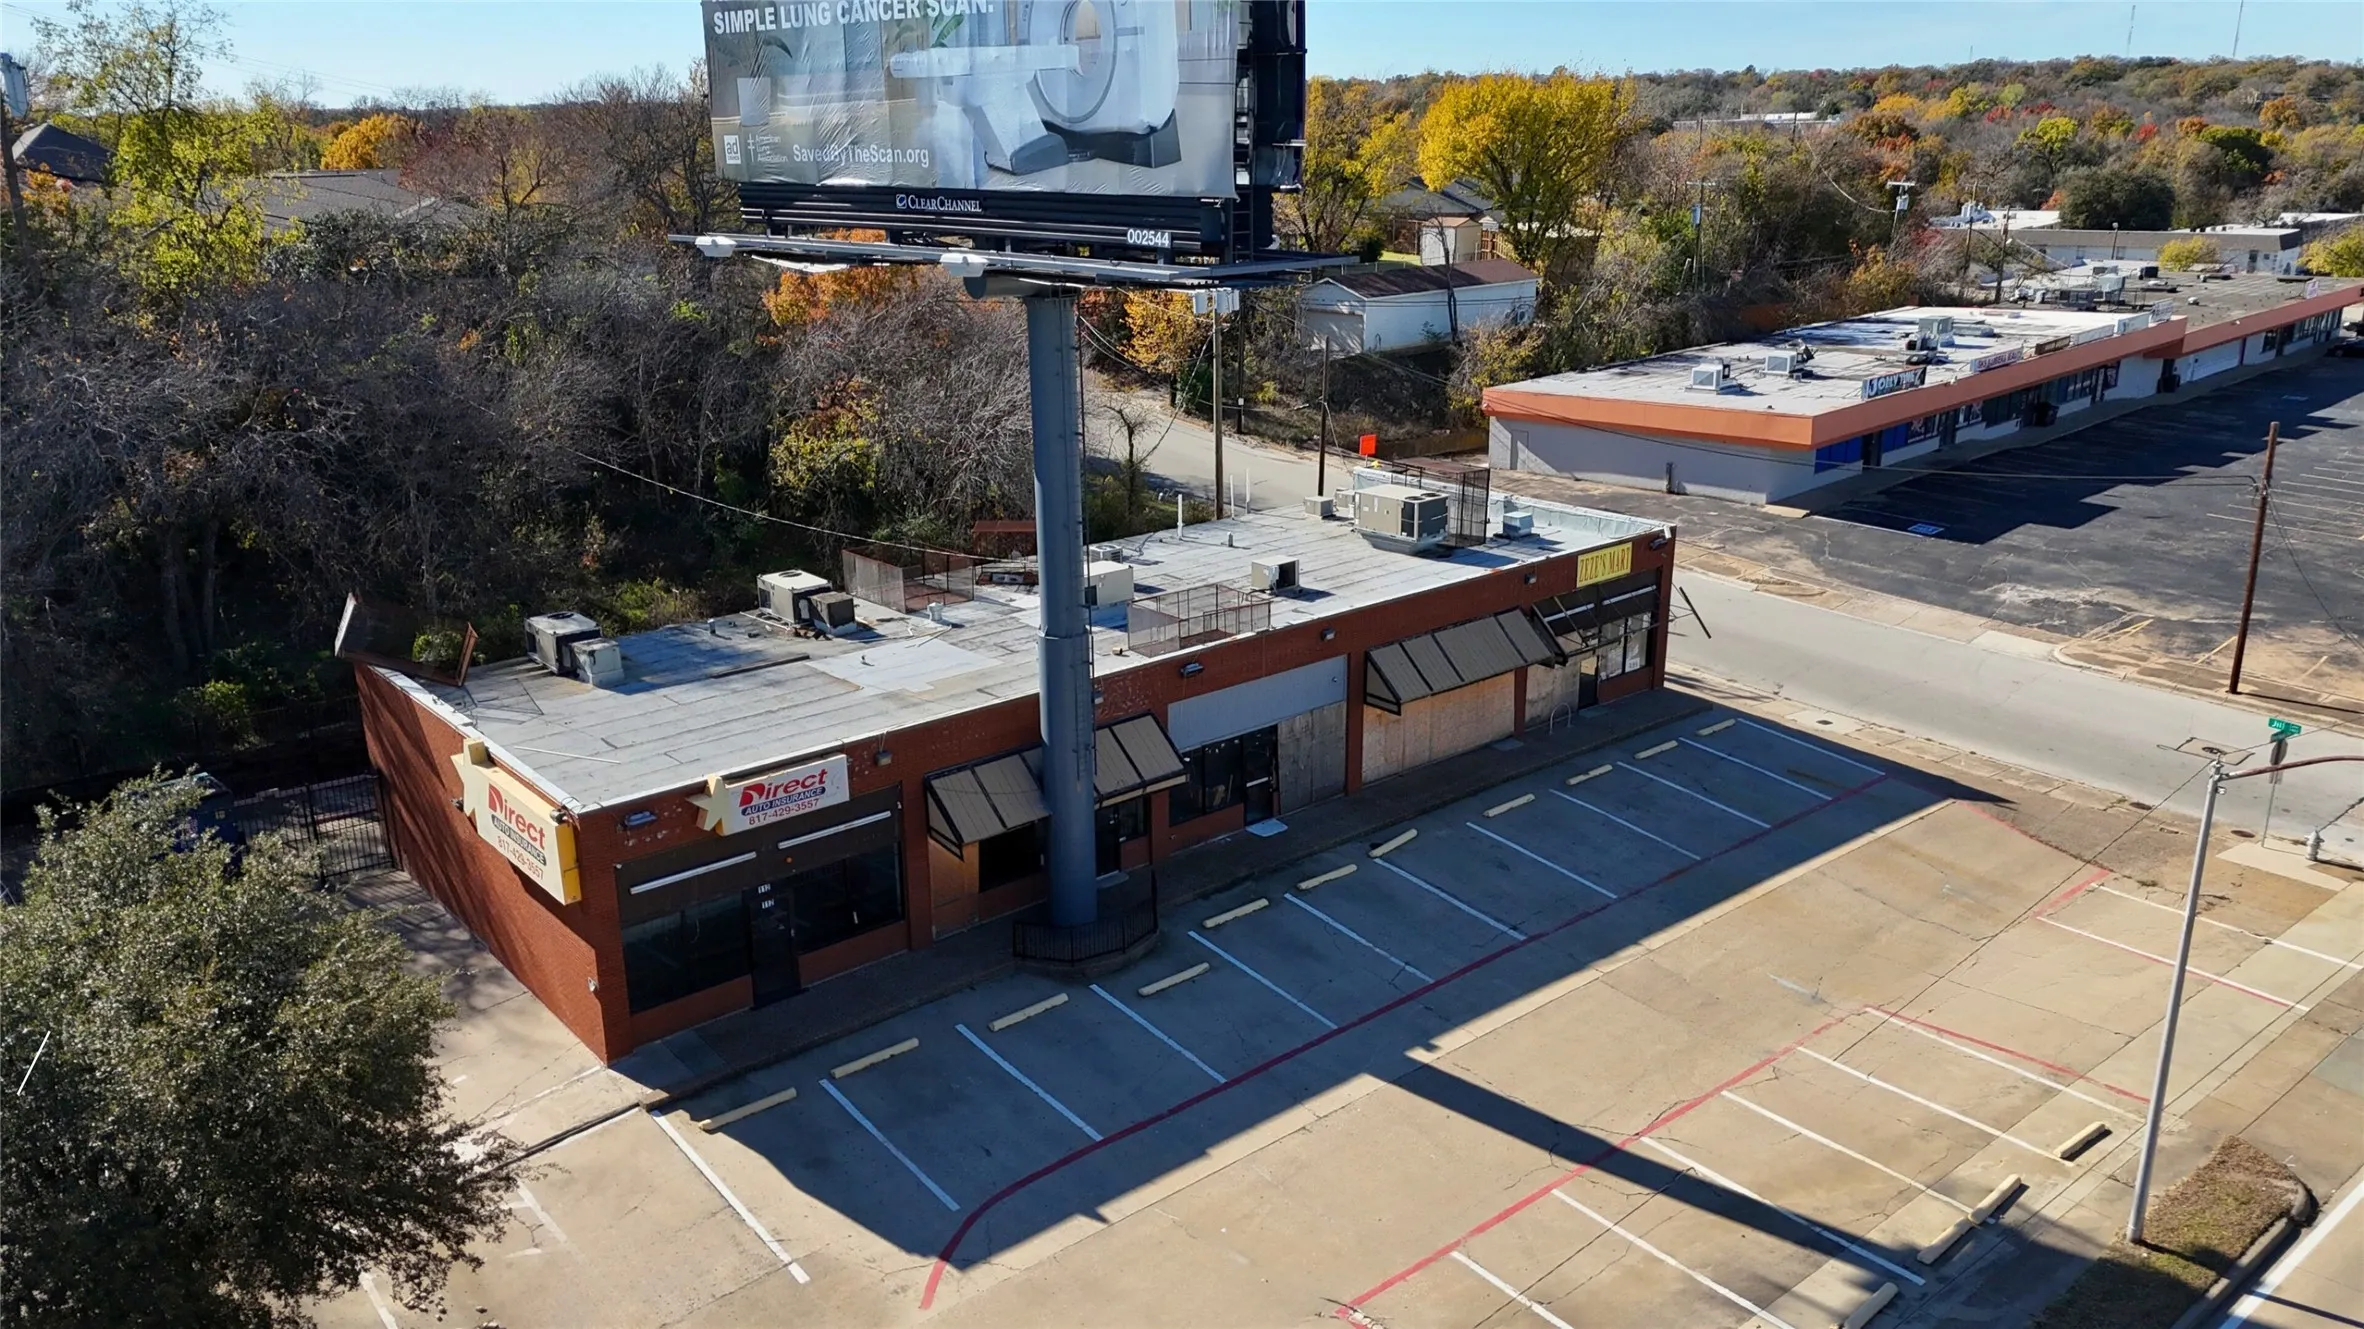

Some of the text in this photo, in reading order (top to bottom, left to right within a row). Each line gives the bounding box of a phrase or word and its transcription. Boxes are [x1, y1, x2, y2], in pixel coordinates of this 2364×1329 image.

[713, 0, 994, 35] SIMPLE LUNG CANCER SCAN.
[792, 143, 930, 168] SavedByTheScan.org
[1127, 228, 1170, 247] 002544
[1578, 546, 1631, 583] ZEZE'S MART
[738, 768, 828, 808] Direct
[745, 788, 823, 815] AUTO INSURANCE
[488, 783, 546, 850] Direct
[748, 798, 820, 826] 817-429-3557
[493, 817, 547, 863] AUTO INSURANCE
